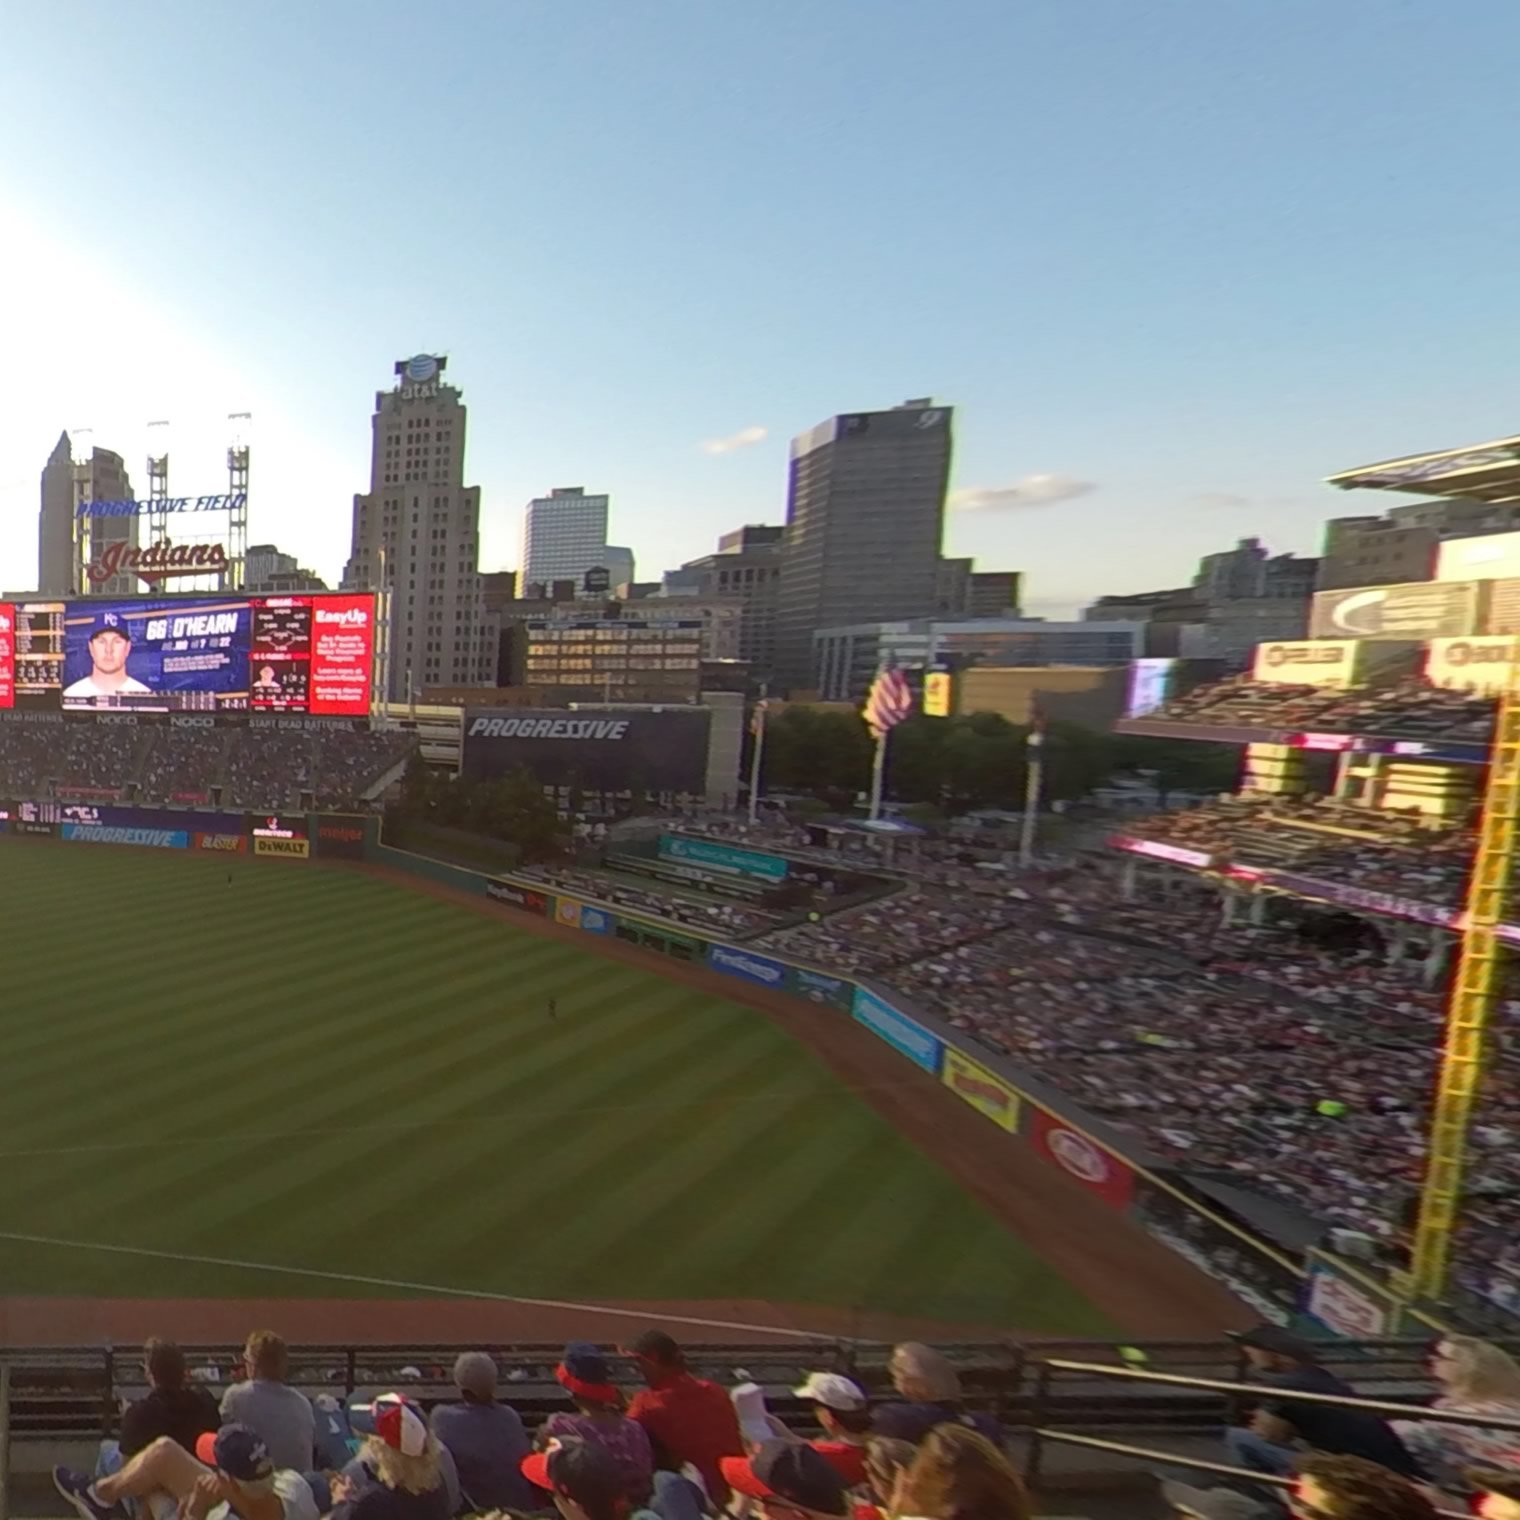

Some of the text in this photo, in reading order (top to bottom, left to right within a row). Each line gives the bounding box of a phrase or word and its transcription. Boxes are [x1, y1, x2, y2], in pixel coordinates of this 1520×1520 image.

[401, 382, 438, 400] at&t
[76, 493, 247, 518] PROGRESSIVE FIELD
[87, 537, 229, 586] Indians
[172, 612, 238, 638] O'HEARN
[315, 608, 368, 625] EasyUp
[96, 714, 138, 726] NOCO
[170, 716, 215, 728] NOCO
[467, 717, 630, 740] PROGRESSIVE
[69, 825, 176, 847] PROGRESSIVE
